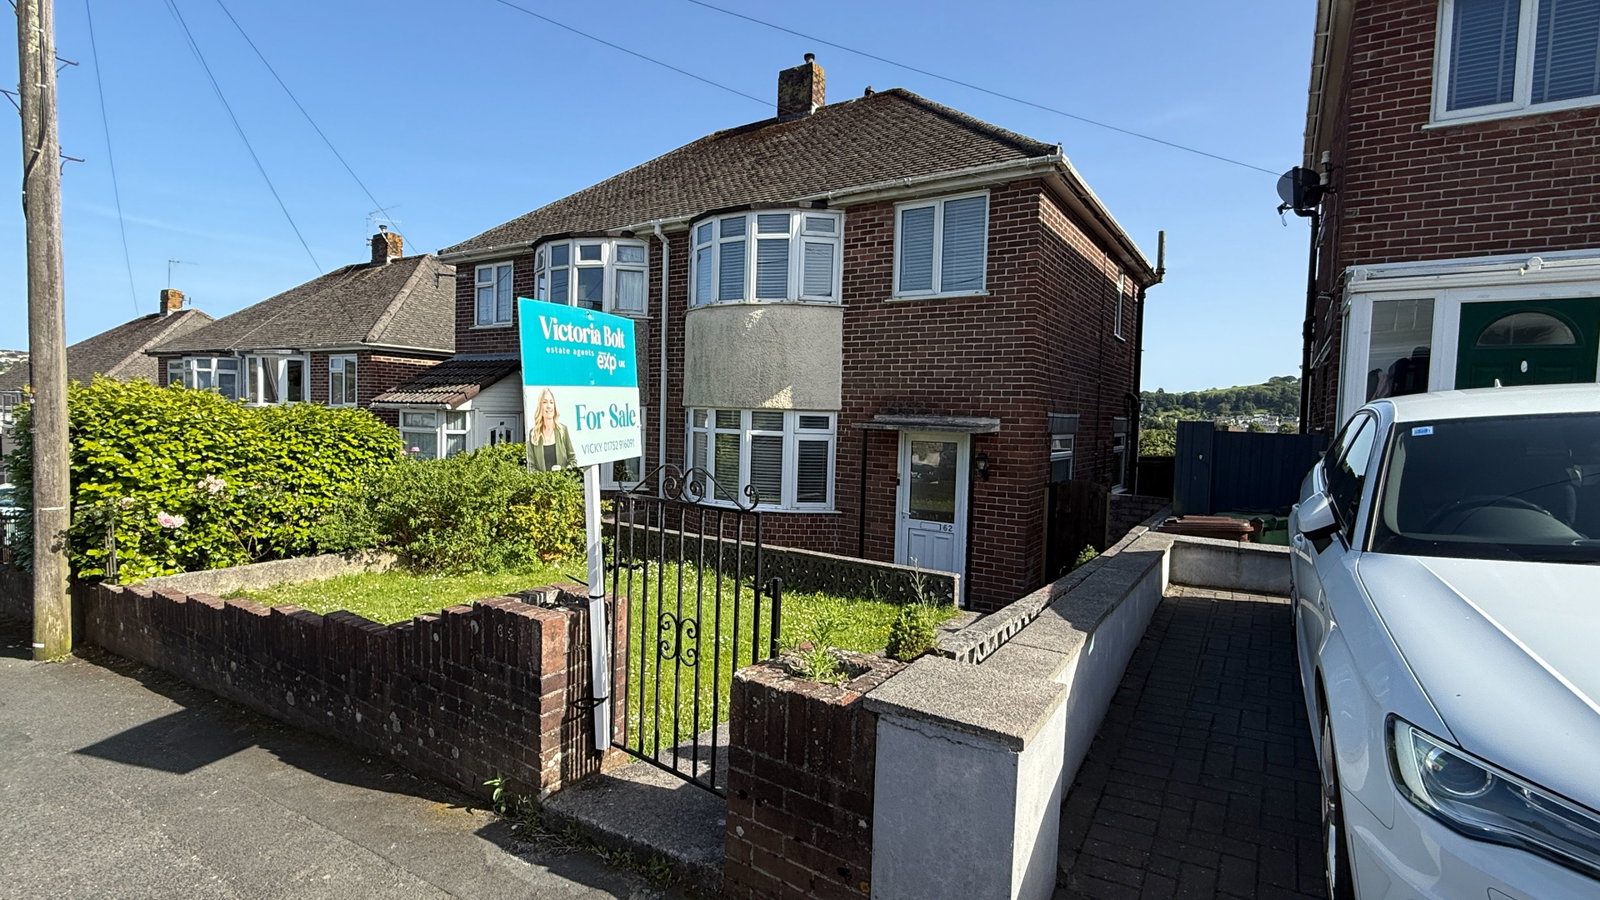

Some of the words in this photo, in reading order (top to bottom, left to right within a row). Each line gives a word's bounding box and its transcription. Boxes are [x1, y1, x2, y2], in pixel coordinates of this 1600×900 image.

[538, 315, 602, 345] Victoria
[603, 325, 626, 349] Bolt
[546, 346, 571, 355] estate
[573, 349, 595, 357] agents
[597, 351, 617, 376] exp
[575, 404, 605, 431] For
[609, 403, 636, 429] Sale
[581, 442, 603, 455] VICKY
[603, 440, 619, 452] 01752
[939, 523, 953, 532] 162
